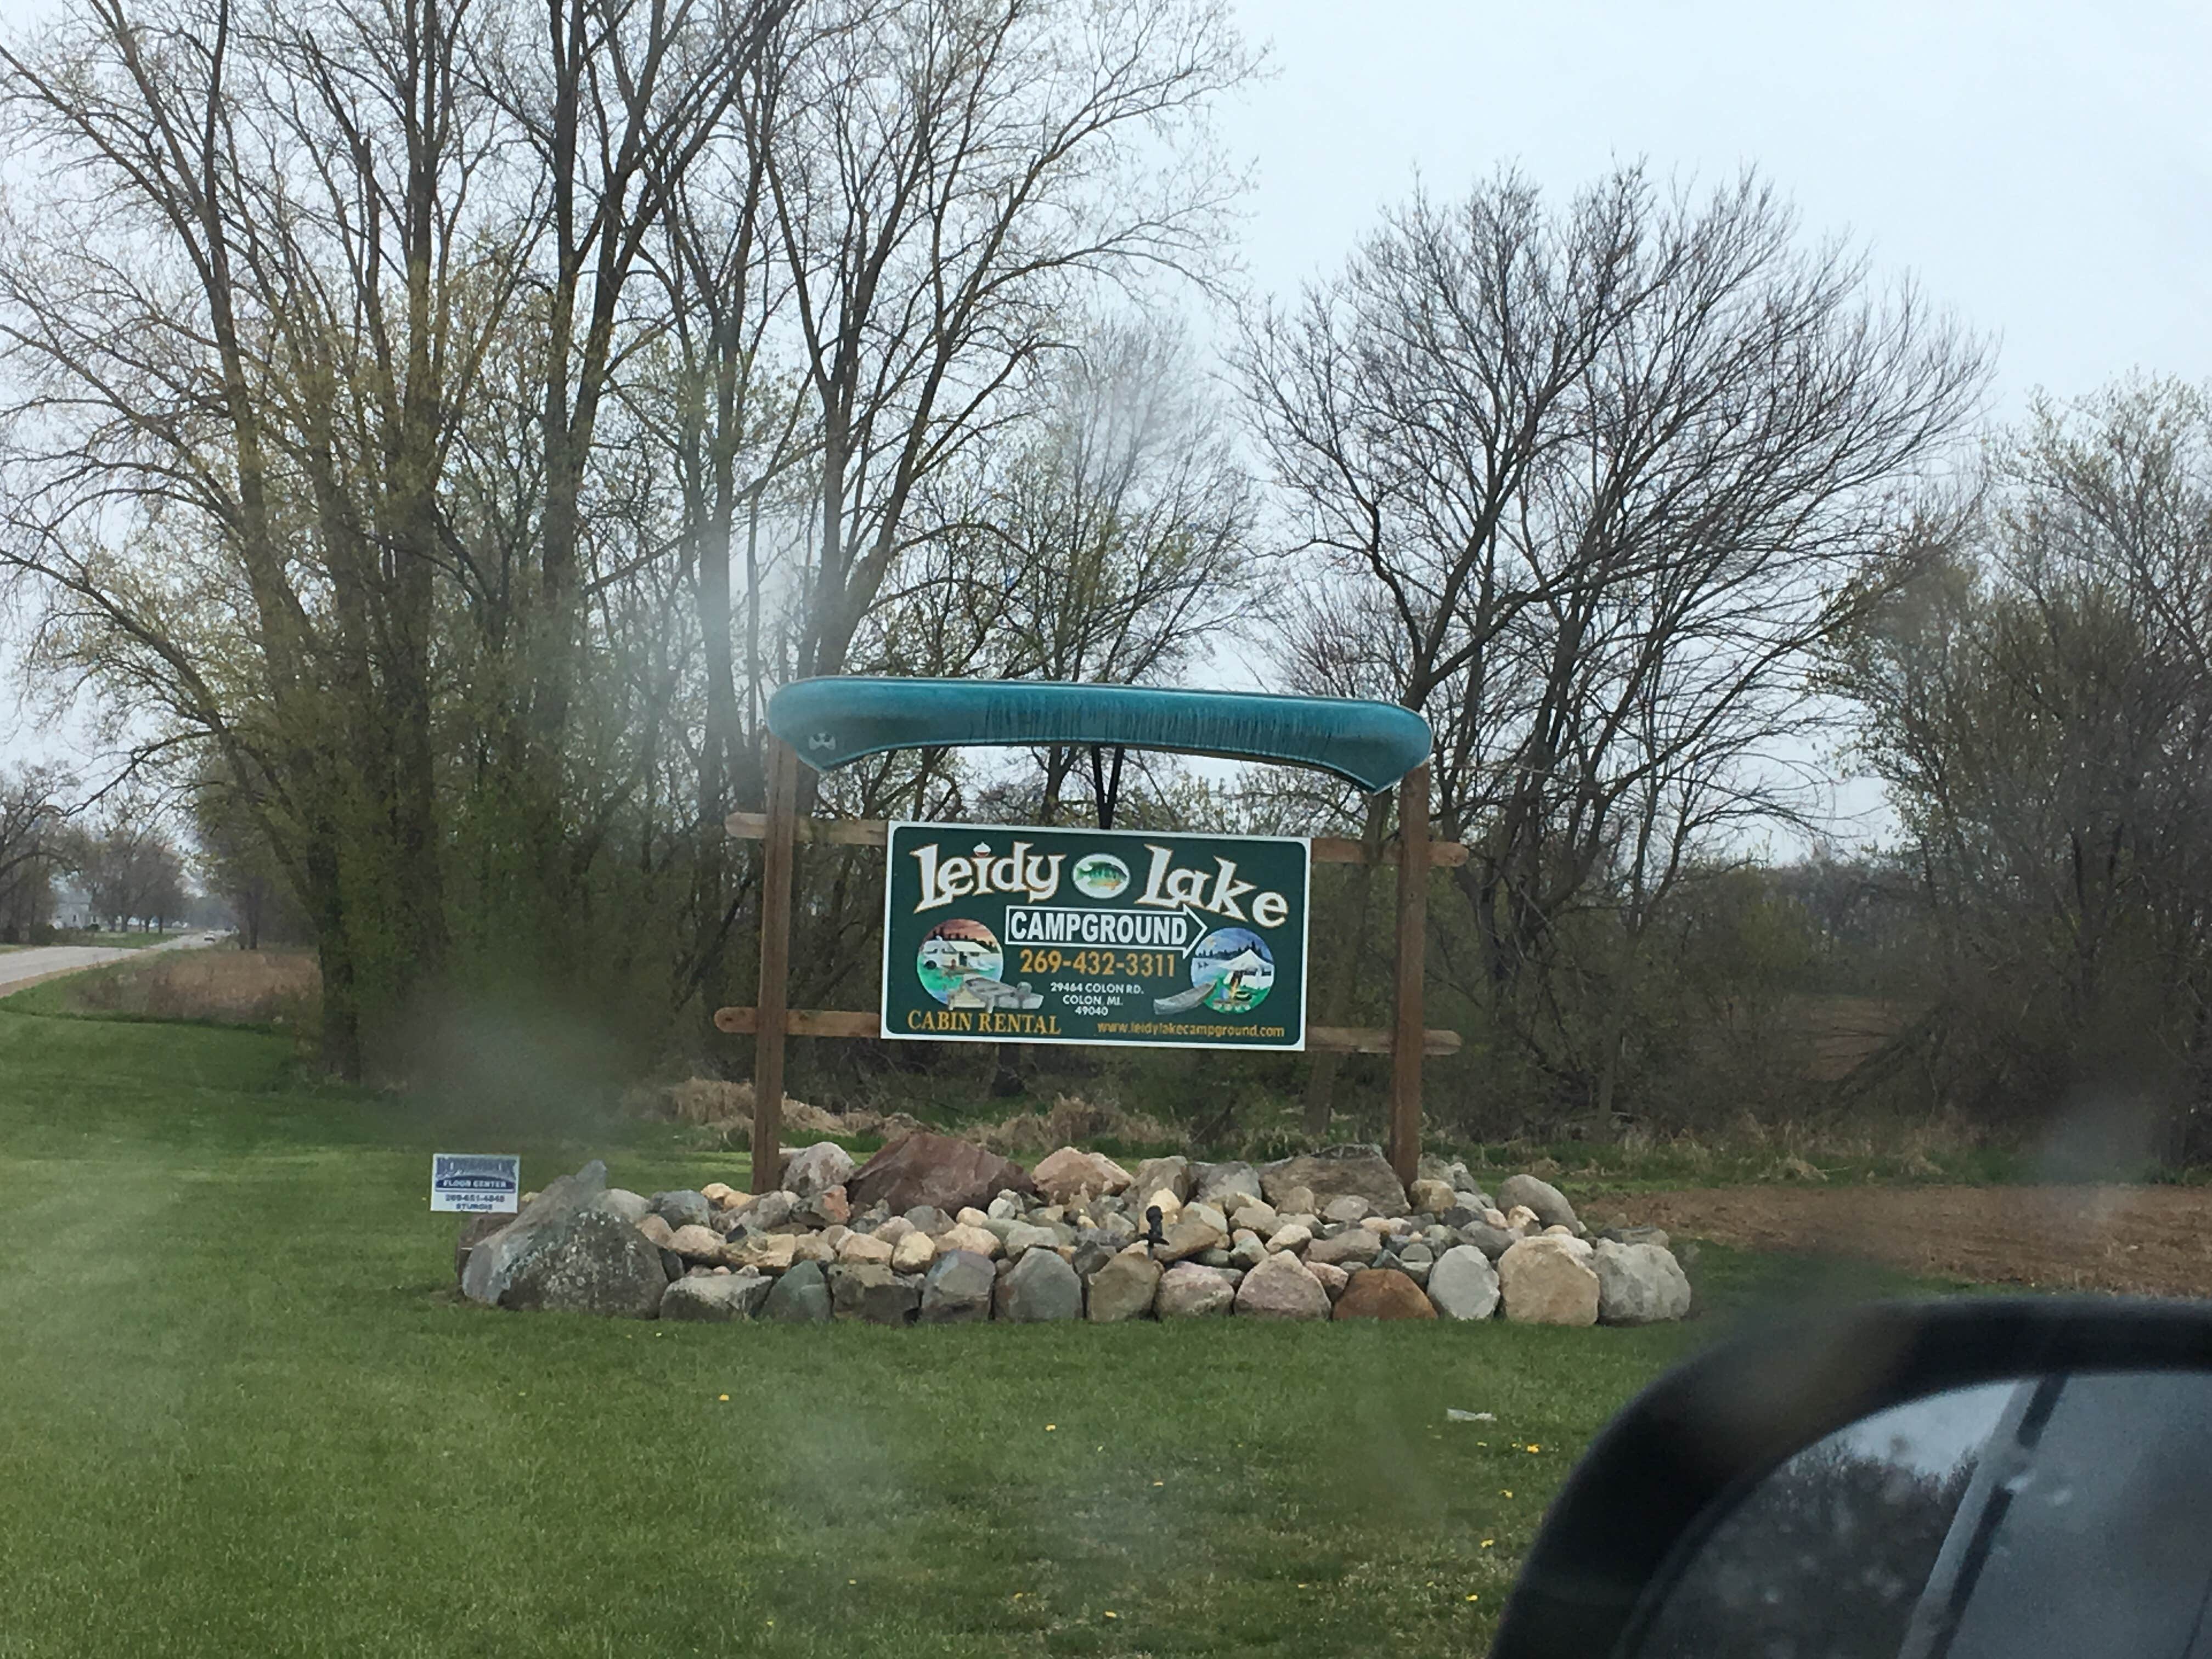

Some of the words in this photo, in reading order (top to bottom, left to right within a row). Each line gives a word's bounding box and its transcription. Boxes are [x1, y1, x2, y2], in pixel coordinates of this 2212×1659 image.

[909, 840, 1067, 915] Leidy
[1133, 843, 1289, 928] Lake
[1011, 911, 1187, 945] CAMPGROUND
[1019, 949, 1175, 978] 269-432-3311
[1050, 981, 1083, 992] 29464
[1085, 983, 1124, 994] COLON
[1126, 984, 1144, 994] RD.
[1107, 996, 1124, 1006] MI.
[1075, 1006, 1109, 1016] 49040
[907, 1009, 973, 1032] CABIN
[978, 1011, 1062, 1035] RENTAL
[1097, 1021, 1284, 1037] www.leidylakecampground.com
[473, 1180, 506, 1188] CENTER
